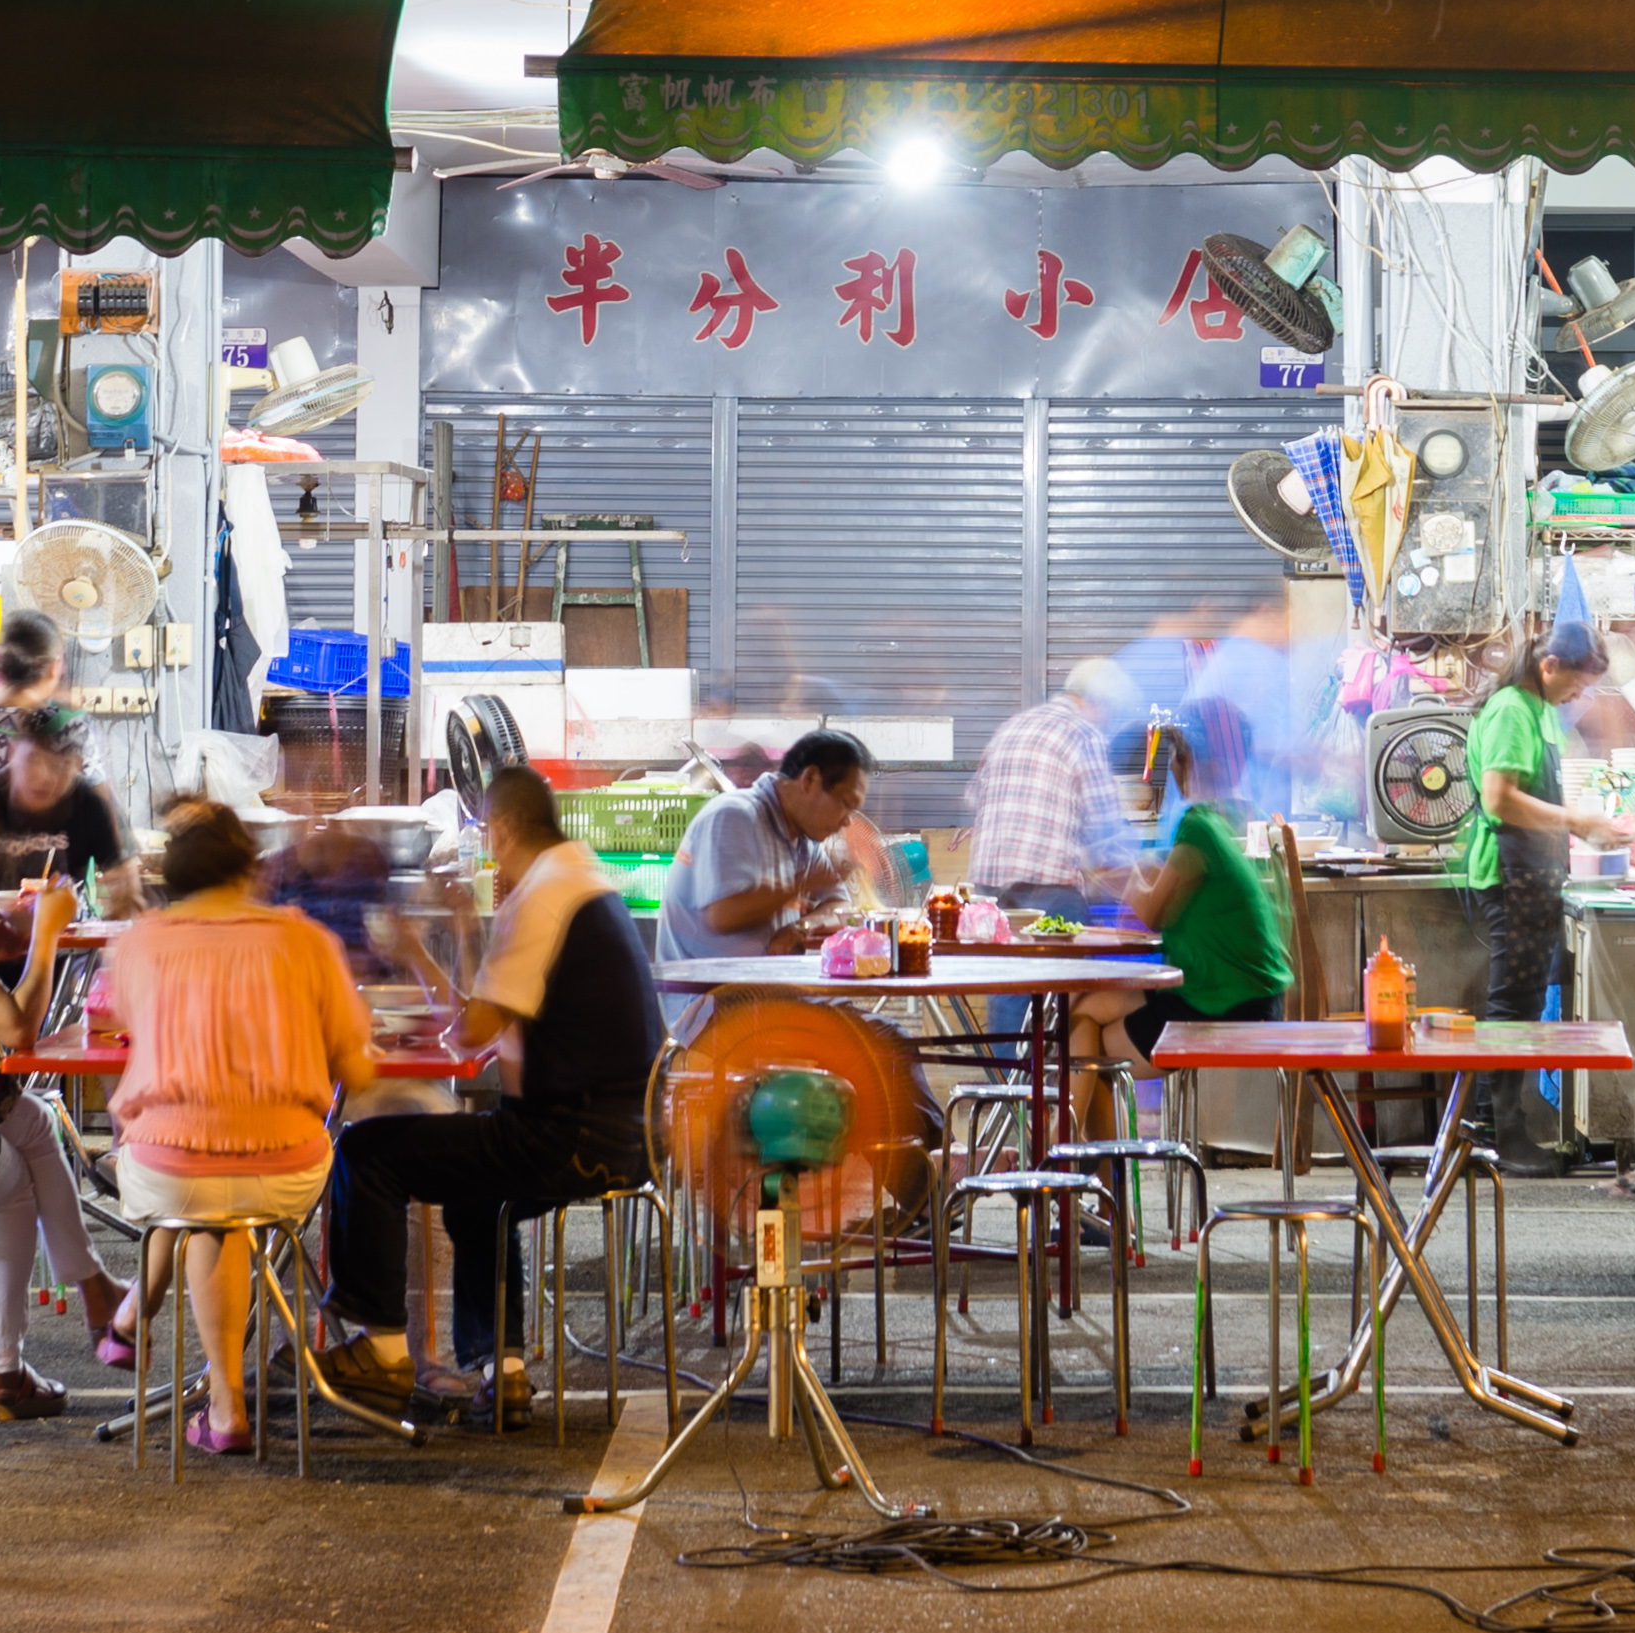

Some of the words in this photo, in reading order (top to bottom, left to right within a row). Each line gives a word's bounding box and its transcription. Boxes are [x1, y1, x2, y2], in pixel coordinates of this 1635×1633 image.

[967, 82, 1148, 119] 23321301
[546, 232, 1253, 350] 半分利小店
[223, 346, 250, 368] 75
[1279, 365, 1306, 387] 77
